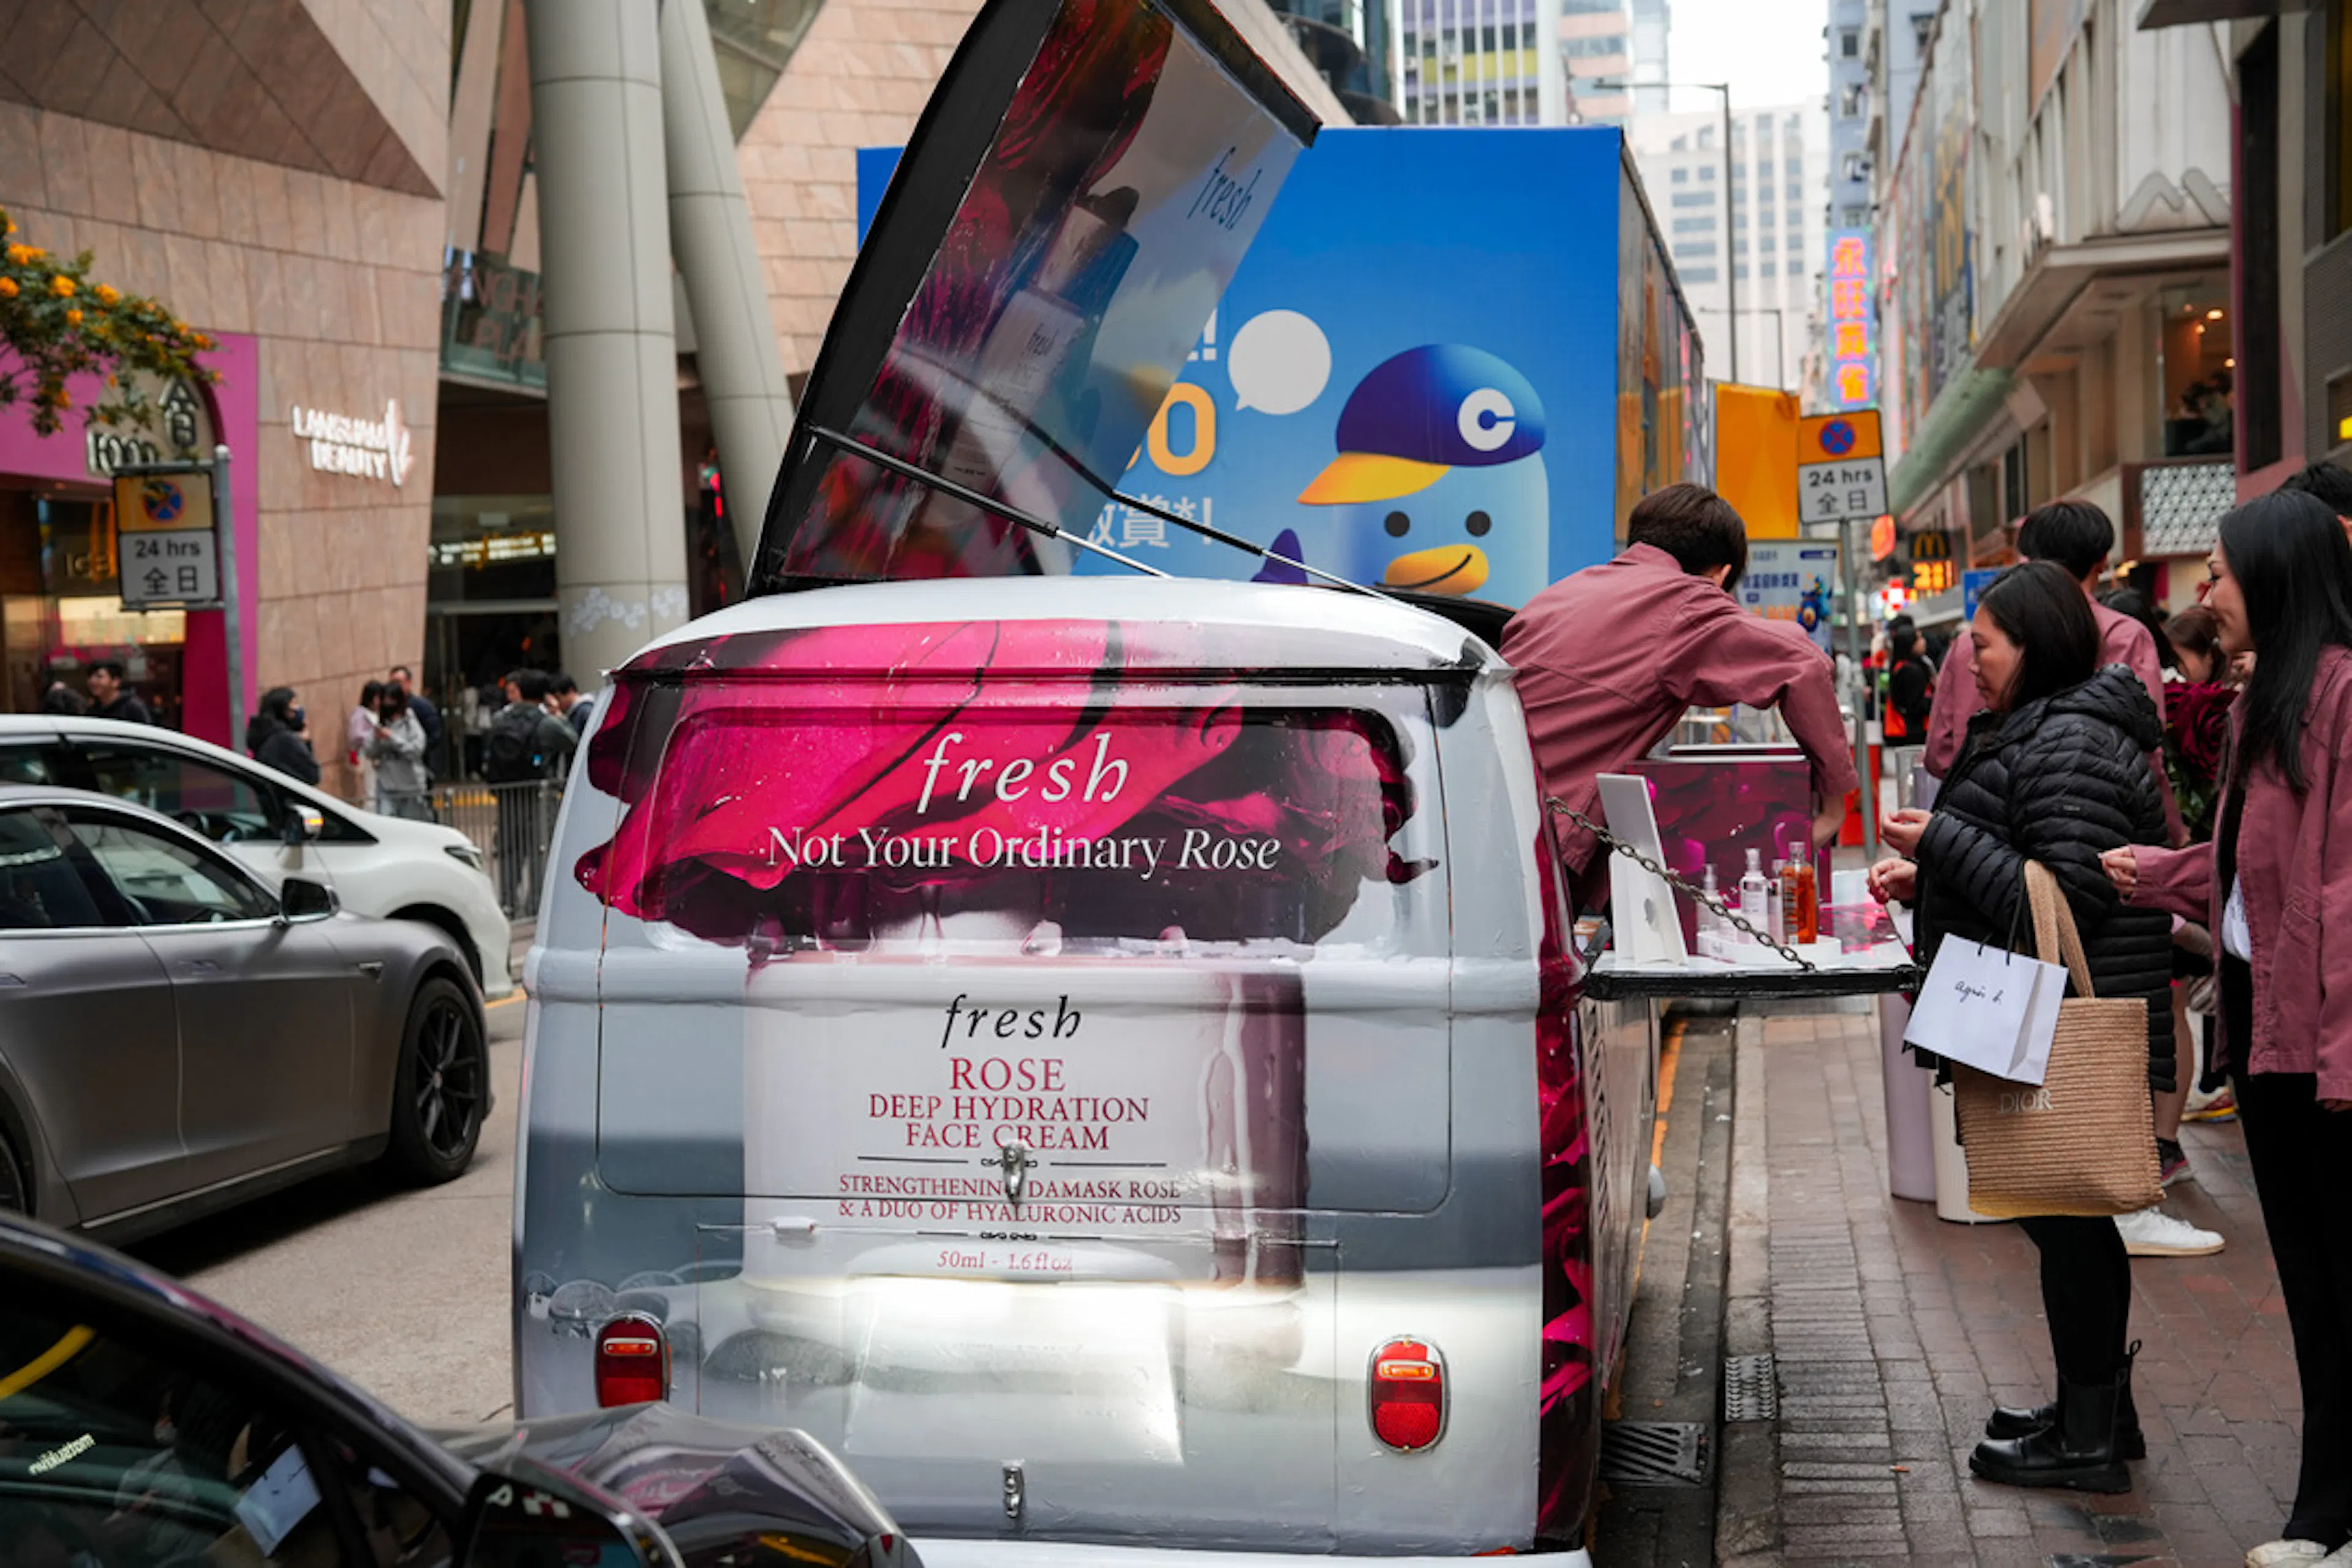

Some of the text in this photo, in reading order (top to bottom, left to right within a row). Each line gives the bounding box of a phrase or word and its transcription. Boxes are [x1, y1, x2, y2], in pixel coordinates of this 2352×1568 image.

[1187, 146, 1262, 230] fresh
[1809, 468, 1874, 487] 24 hrs
[1817, 489, 1868, 515] 全日
[134, 539, 201, 559] 24 hrs
[143, 566, 198, 595] 全日
[918, 733, 1129, 813] fresh
[767, 826, 1281, 880] Not Your Ordinary Rose
[941, 994, 1081, 1049] fresh
[949, 1058, 1066, 1091] ROSE
[869, 1094, 1149, 1122] DEEP HYDRATION
[1999, 1089, 2052, 1114] DIOR
[906, 1123, 1109, 1150] FACE CREAM
[839, 1174, 1181, 1199] STRENGTHENIN DAMASK ROSE
[839, 1199, 1181, 1224] & A DUO OF HYALURONIC ACIDS
[937, 1250, 986, 1268] 50ml
[1008, 1253, 1031, 1270] 1.6
